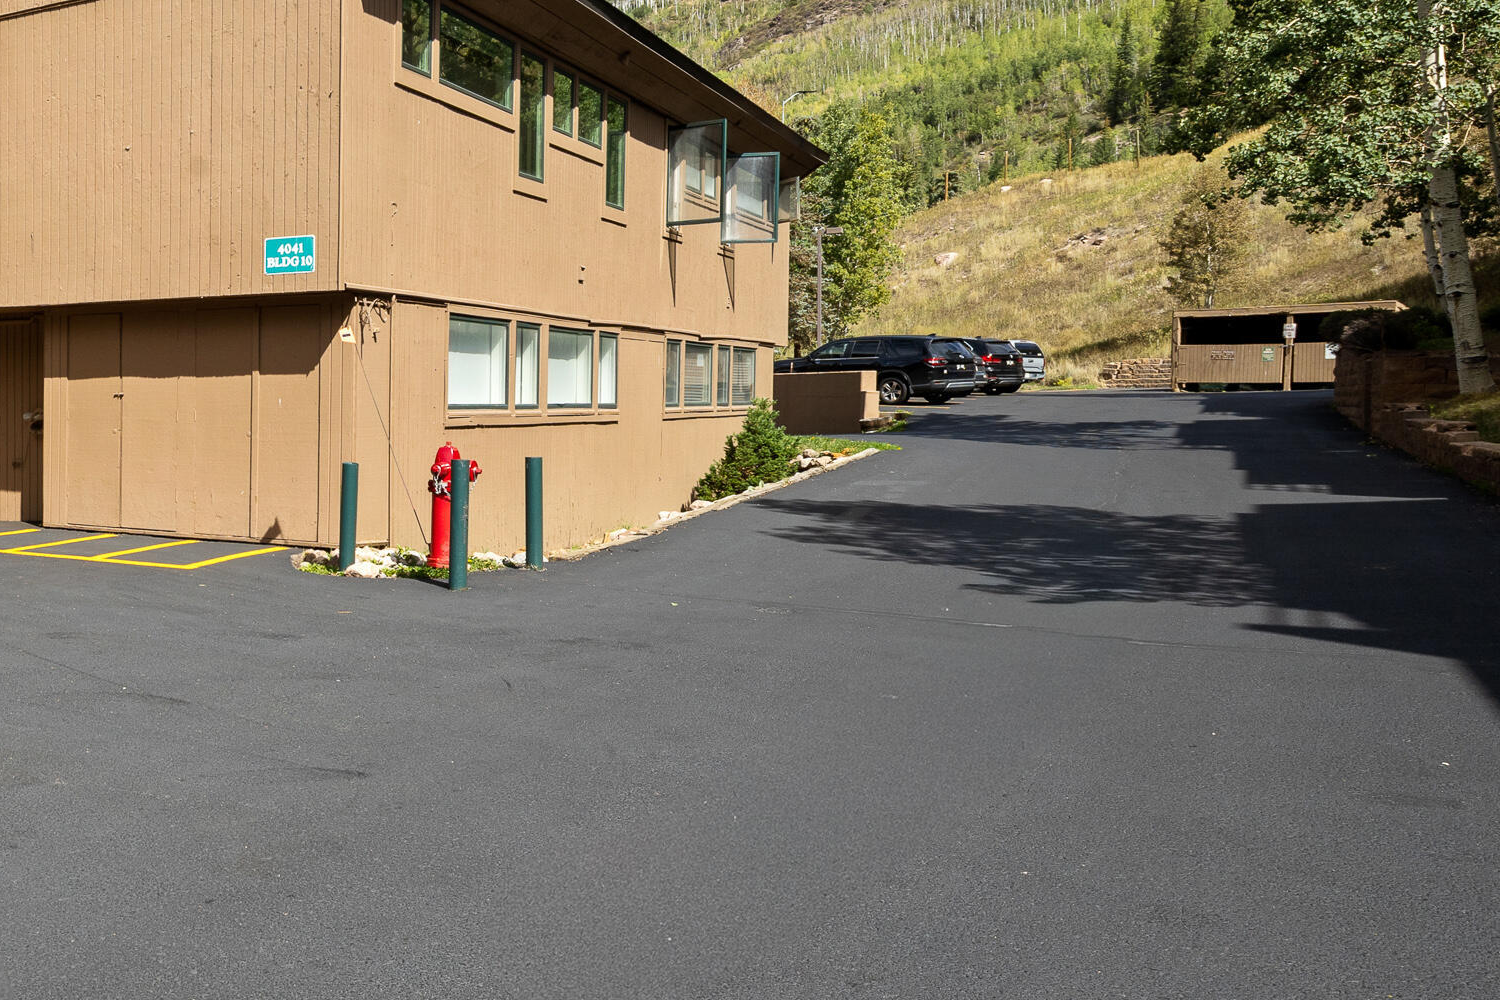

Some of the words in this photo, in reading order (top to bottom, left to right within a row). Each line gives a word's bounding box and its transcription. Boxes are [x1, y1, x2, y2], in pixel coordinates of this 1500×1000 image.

[277, 243, 304, 255] 4041
[267, 256, 300, 268] BLDG
[301, 255, 313, 266] 10
